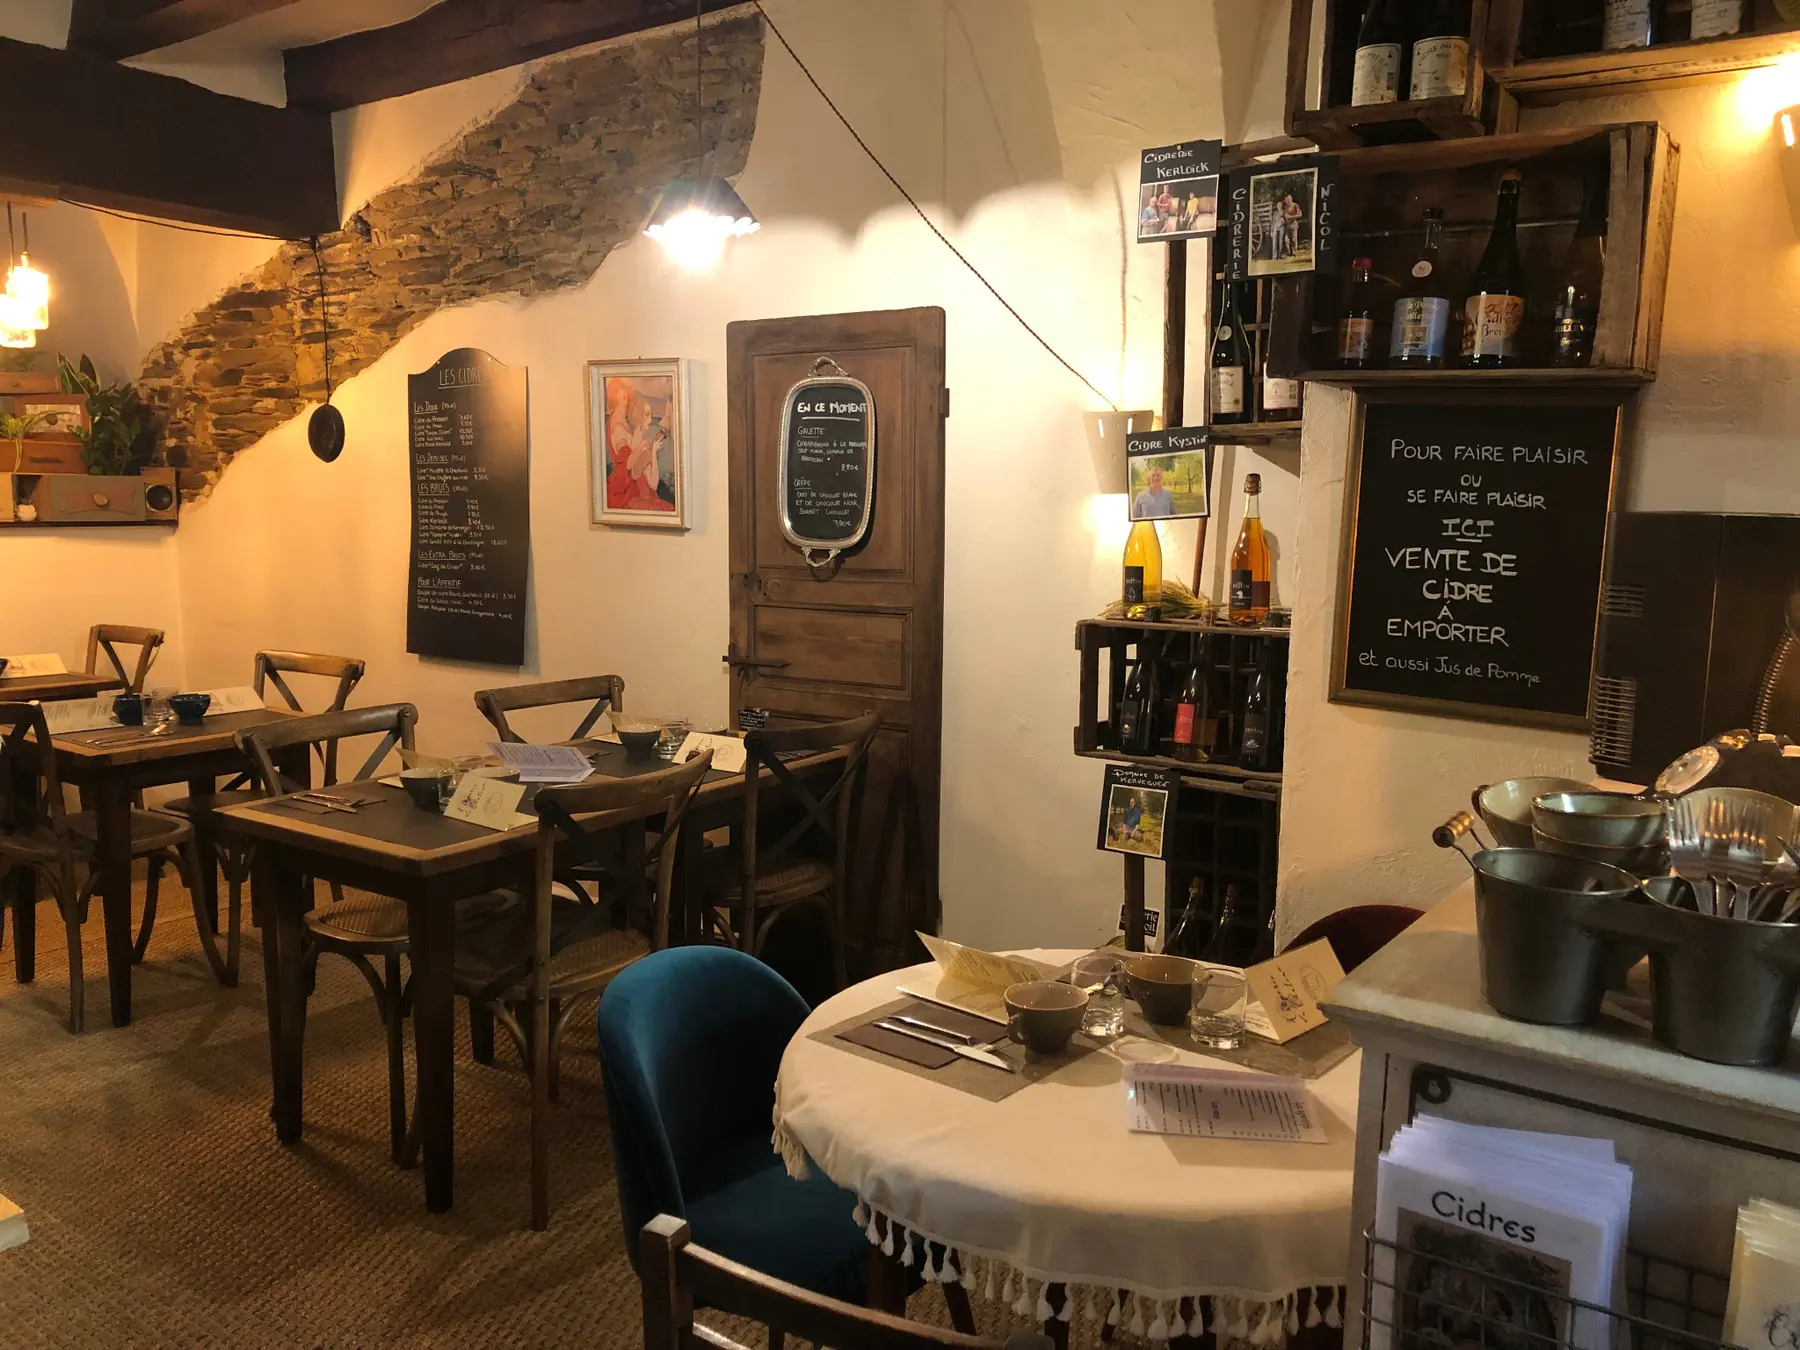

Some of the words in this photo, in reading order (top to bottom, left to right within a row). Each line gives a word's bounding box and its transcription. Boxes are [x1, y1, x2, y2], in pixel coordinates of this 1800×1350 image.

[1319, 183, 1334, 251] NICOL
[1232, 188, 1248, 280] CIDRERIE
[439, 369, 455, 385] LES
[797, 402, 810, 413] EN
[815, 403, 825, 412] CE
[829, 402, 867, 414] MOMENT
[797, 426, 824, 435] GALETTE
[1128, 441, 1163, 451] CIDRE
[1390, 438, 1443, 461] POUR
[1454, 444, 1504, 462] FAIRE
[1512, 446, 1588, 464] PLAISIR
[418, 483, 428, 493] LES
[430, 483, 449, 493] BRUTS
[1460, 474, 1482, 488] OU
[1407, 489, 1426, 504] SE
[1434, 489, 1479, 505] FAIRE
[1487, 492, 1547, 510] PLAISIR
[1442, 518, 1495, 538] ICI
[1384, 547, 1472, 572] VENTE
[1480, 552, 1518, 576] DE
[1422, 578, 1493, 604] CIDRE
[1387, 618, 1510, 648] EMPORTER
[1358, 648, 1379, 666] et
[1385, 657, 1430, 672] aussi
[1434, 656, 1460, 676] Jus
[1464, 664, 1483, 678] de
[1488, 663, 1541, 687] Pomme
[1430, 1190, 1537, 1244] Cidres
